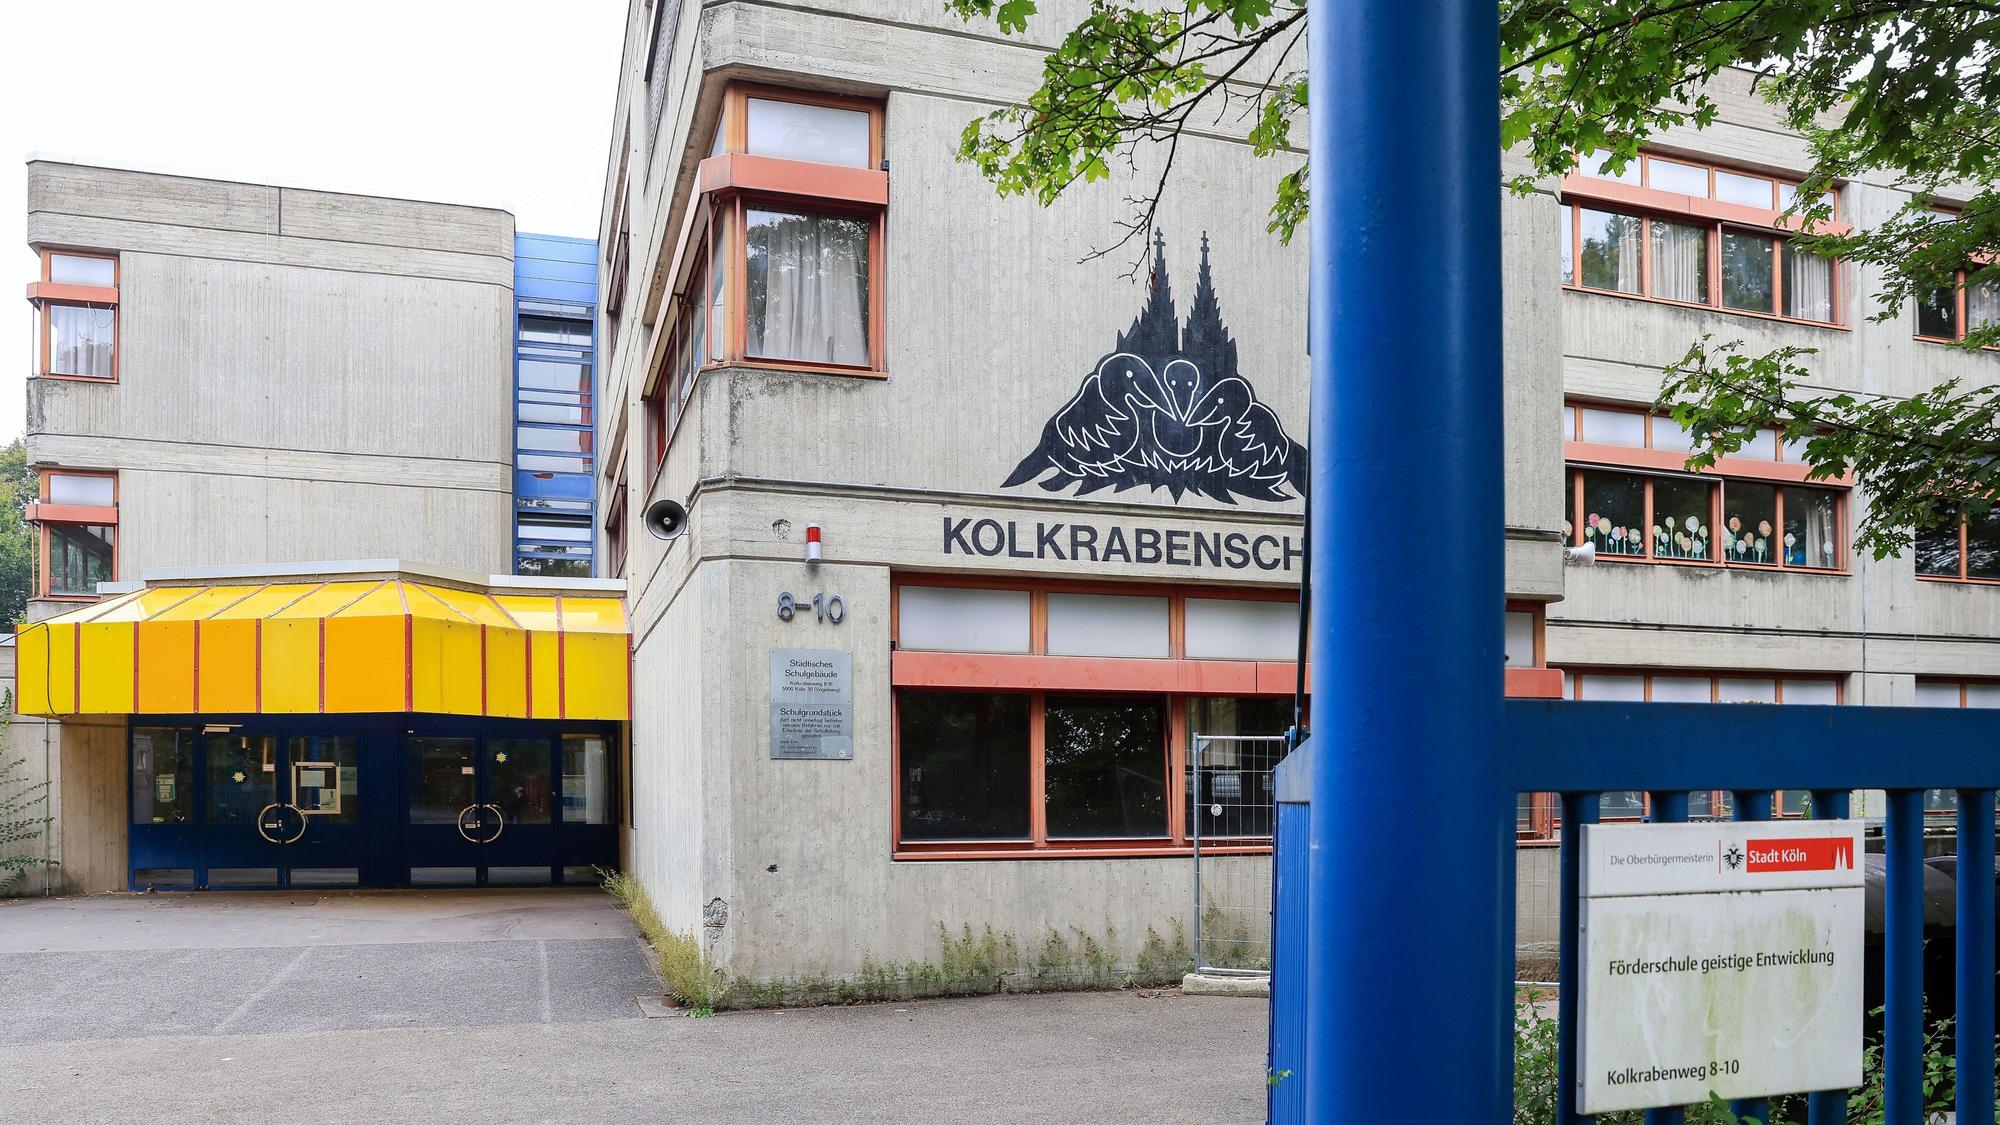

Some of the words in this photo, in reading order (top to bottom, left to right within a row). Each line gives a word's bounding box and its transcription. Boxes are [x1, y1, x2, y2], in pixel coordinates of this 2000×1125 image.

[777, 591, 846, 624] 8-10
[789, 659, 833, 668] Städtisches
[785, 669, 838, 679] Schulgebäude
[780, 708, 843, 718] Schulgrundstück
[1610, 854, 1625, 865] Die
[1626, 852, 1714, 867] Oberbürgermeisterin
[1749, 848, 1780, 863] Stadt
[1781, 847, 1807, 862] Köln
[1609, 956, 1698, 976] Förderschule
[1701, 952, 1753, 974] geistige
[1756, 948, 1835, 967] Entwicklung
[1607, 1063, 1706, 1086] Kolkrabenweg
[1709, 1059, 1740, 1076] 8-10
